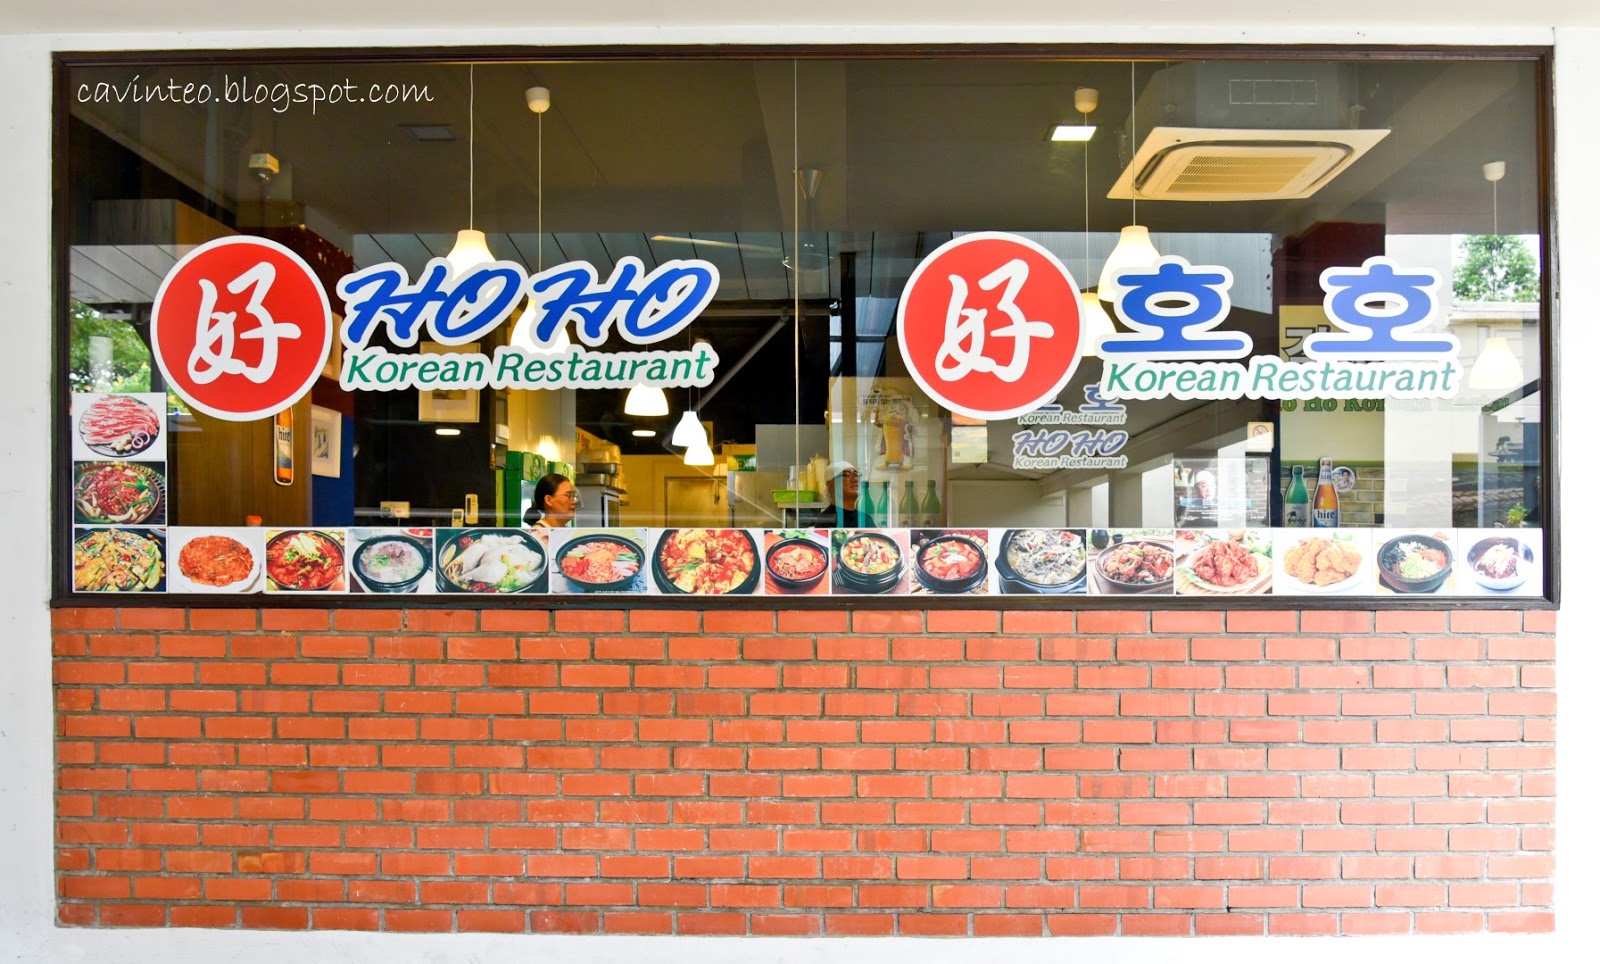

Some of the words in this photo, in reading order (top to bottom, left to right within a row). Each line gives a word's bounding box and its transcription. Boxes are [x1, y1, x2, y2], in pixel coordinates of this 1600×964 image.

[344, 264, 522, 344] HO
[532, 263, 713, 343] HO
[1101, 263, 1245, 353] 호
[1310, 264, 1453, 353] 호
[189, 262, 301, 384] 好
[936, 259, 1055, 383] 好
[347, 353, 485, 384] Korean
[496, 350, 713, 383] Restaurant
[1107, 362, 1241, 392] Korean
[1252, 361, 1456, 392] Restaurant
[1020, 413, 1060, 423] Korean
[1063, 411, 1126, 423] Restaurant
[1014, 431, 1069, 455] HO
[1072, 431, 1127, 455] HO
[1015, 456, 1058, 467] Korean
[1061, 455, 1126, 467] Restaurant
